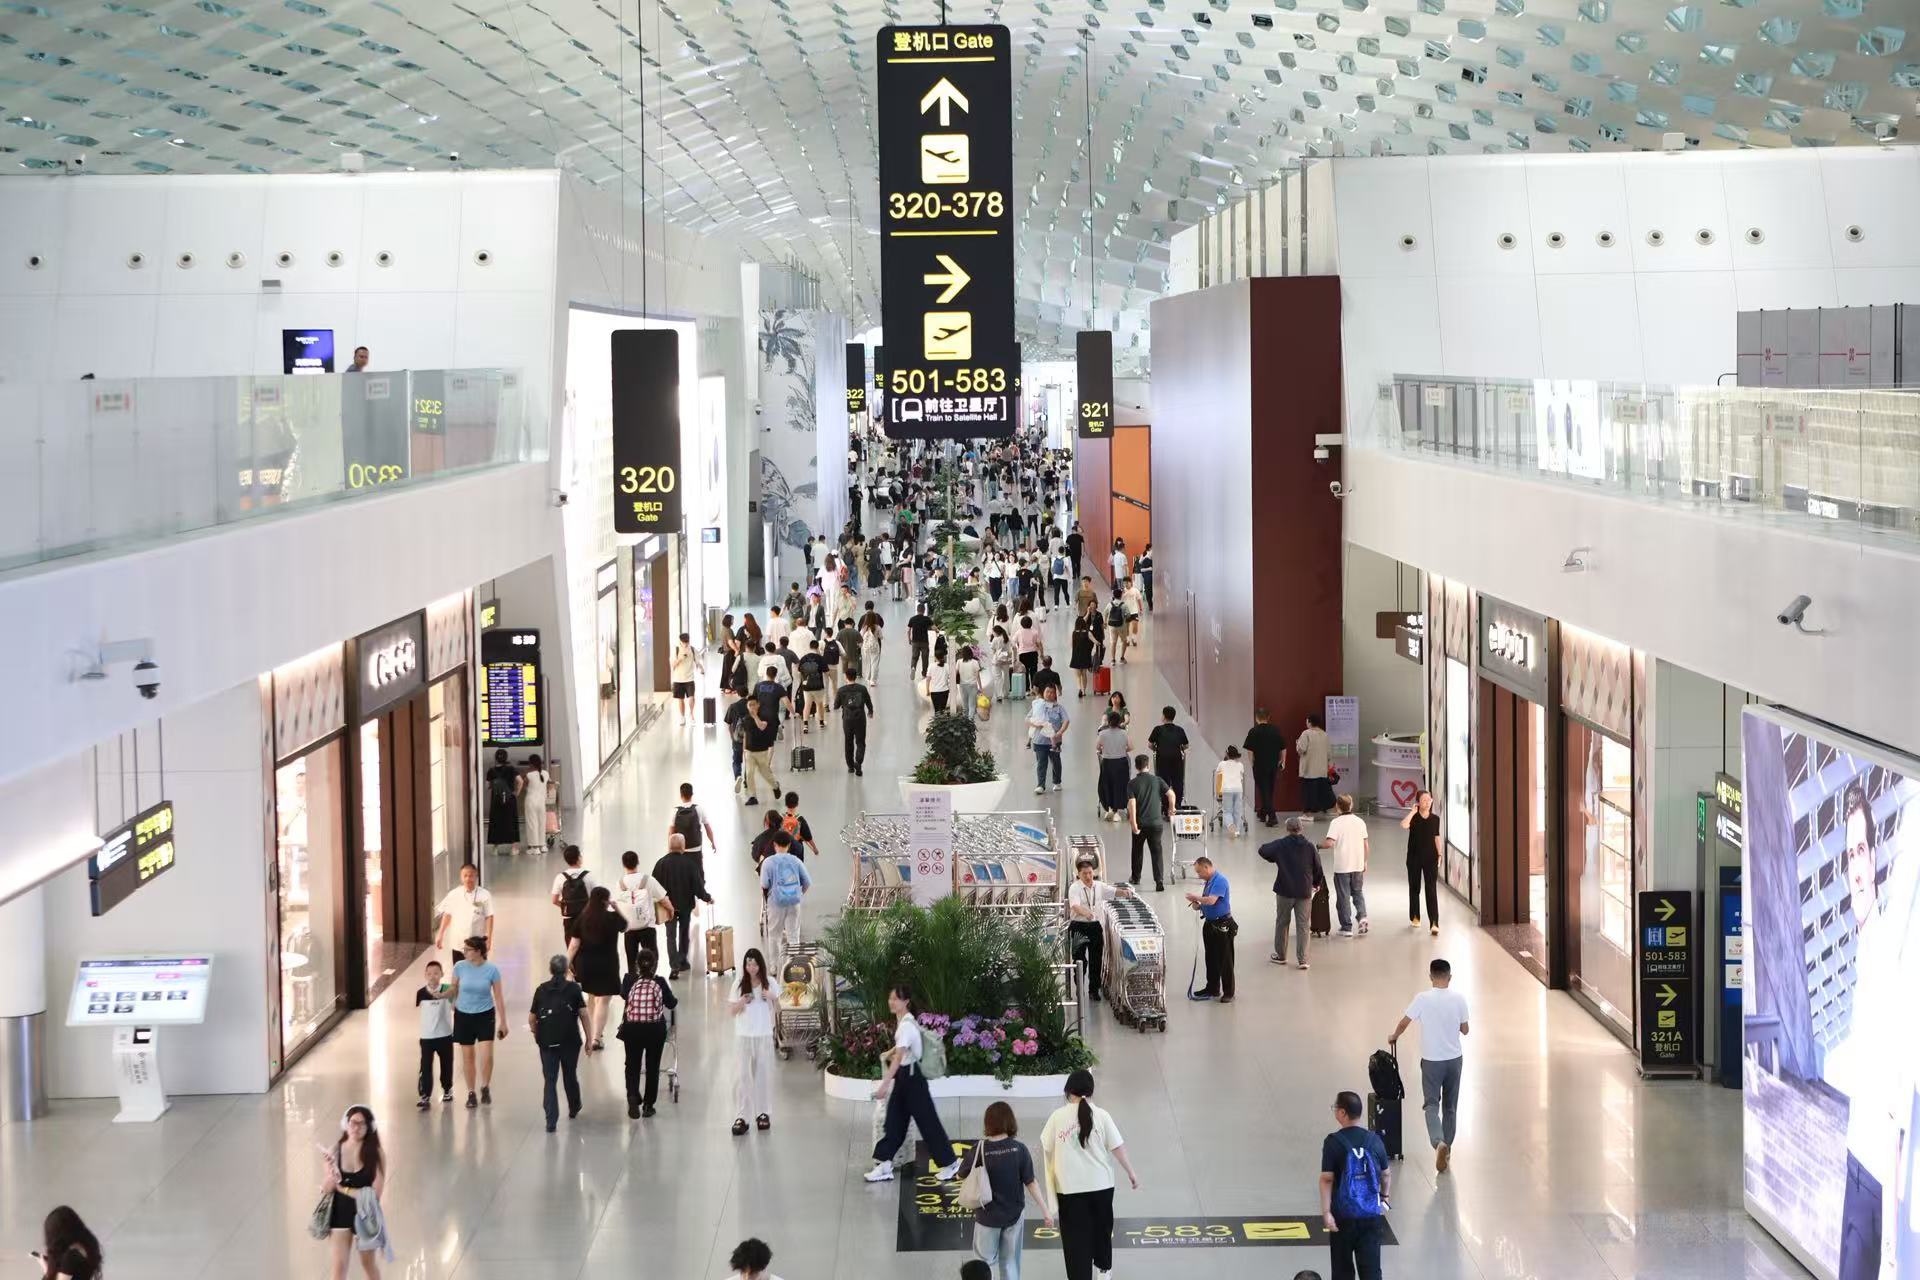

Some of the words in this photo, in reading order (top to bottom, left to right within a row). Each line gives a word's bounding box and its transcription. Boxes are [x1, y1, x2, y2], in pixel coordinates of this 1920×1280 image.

[893, 33, 949, 51] 登机口
[954, 33, 993, 49] Gate
[889, 192, 1004, 219] 320-378
[892, 368, 1007, 394] 501-583
[846, 388, 865, 399] 322
[924, 397, 998, 413] 前往卫星厅
[1082, 402, 1109, 418] 321
[925, 413, 944, 422] Train
[945, 413, 952, 421] to
[620, 466, 675, 494] 320
[633, 501, 663, 512] 登机口
[637, 513, 659, 522] Gate
[1645, 951, 1687, 961] 501-583
[1651, 1031, 1683, 1041] 321A
[1655, 1043, 1680, 1052] 登机口
